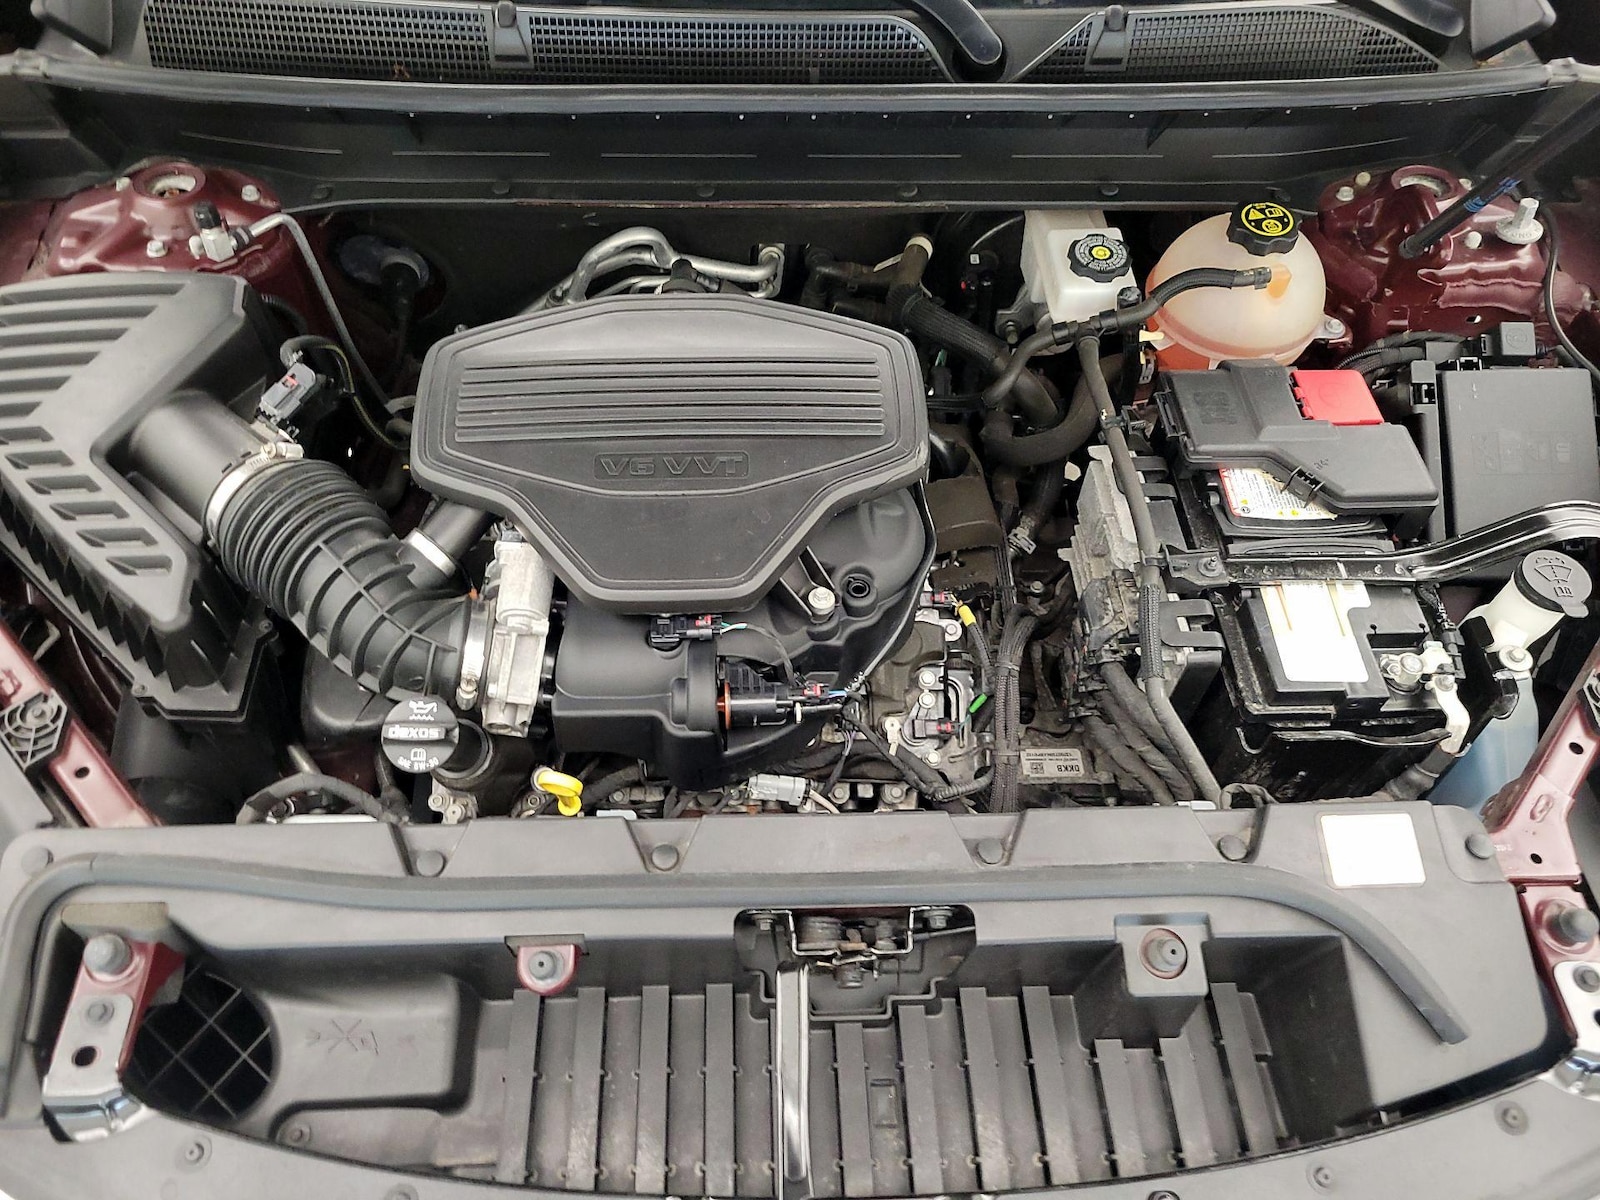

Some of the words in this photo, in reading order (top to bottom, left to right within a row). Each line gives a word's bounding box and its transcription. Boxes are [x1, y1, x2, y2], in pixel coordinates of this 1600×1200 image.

[600, 456, 655, 476] V6
[662, 455, 743, 475] VVT
[388, 724, 440, 738] dexos
